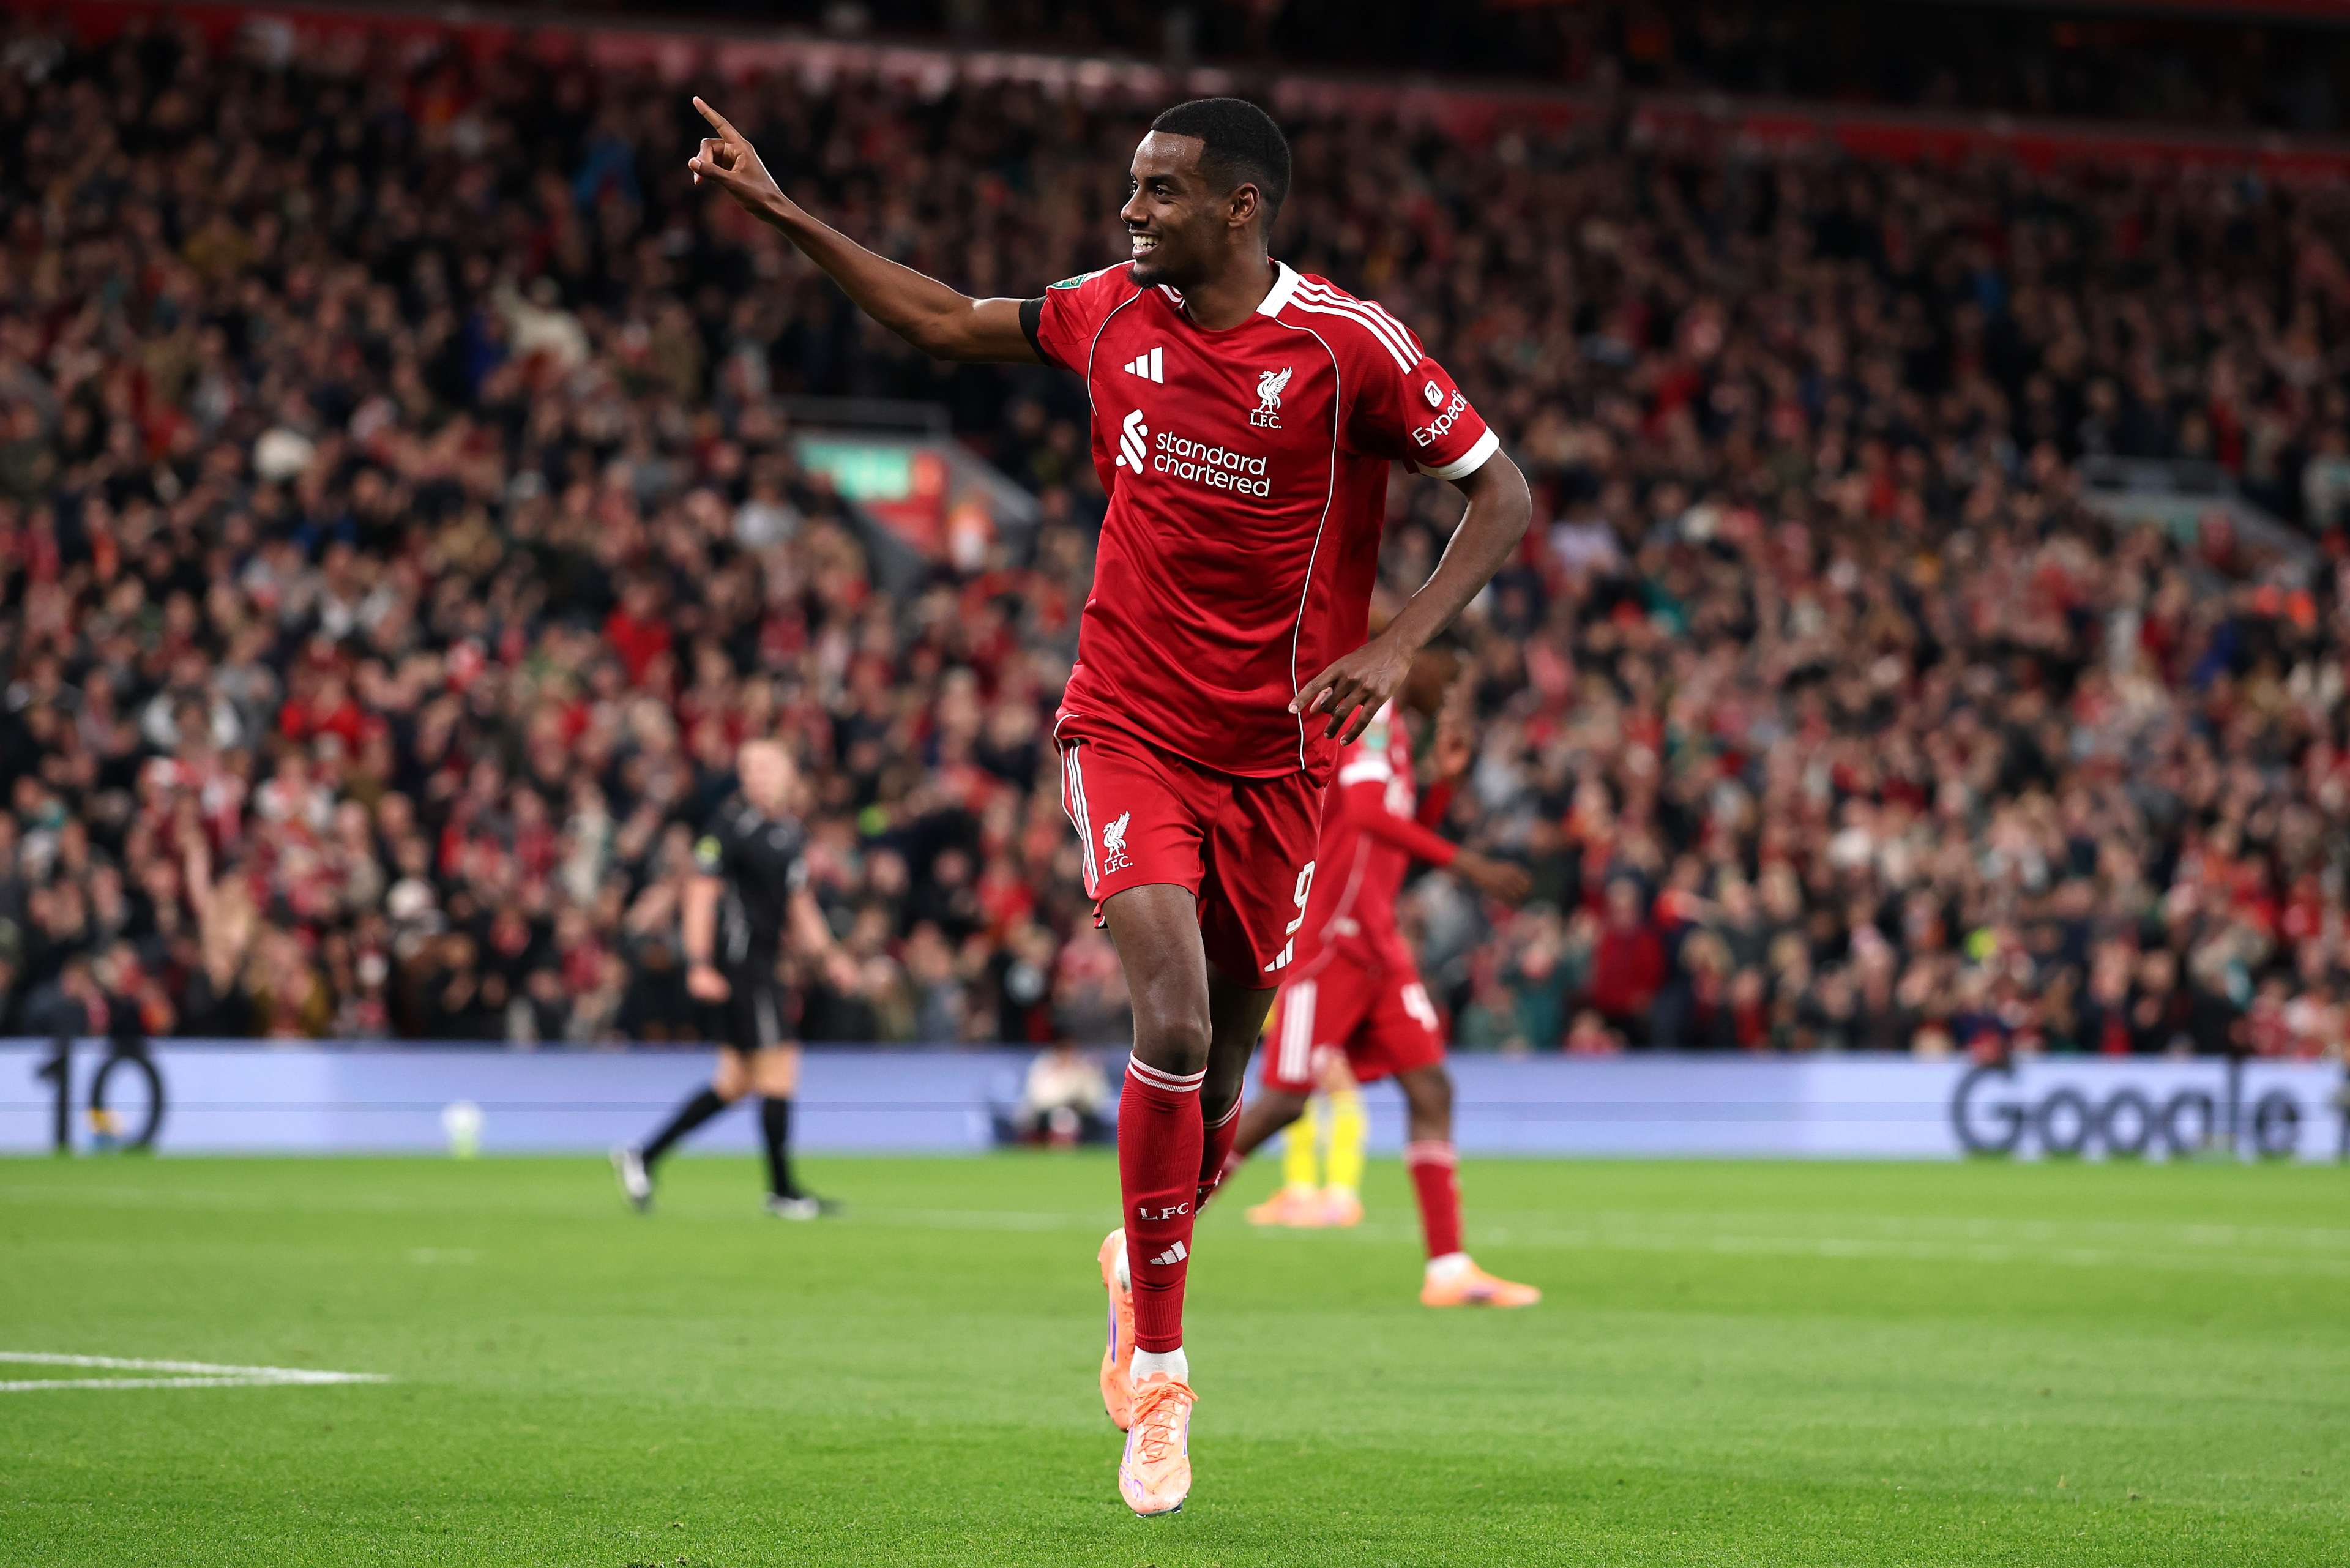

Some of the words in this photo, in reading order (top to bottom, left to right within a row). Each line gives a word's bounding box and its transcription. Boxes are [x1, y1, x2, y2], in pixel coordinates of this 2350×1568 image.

[1250, 413, 1283, 429] L.F.C.
[1412, 389, 1468, 447] Expedi
[1154, 453, 1270, 498] chartered
[1155, 431, 1267, 476] standard
[1104, 856, 1133, 876] L.F.C.
[1285, 860, 1316, 936] 9
[32, 1036, 166, 1155] 10
[1139, 1202, 1189, 1220] LFC
